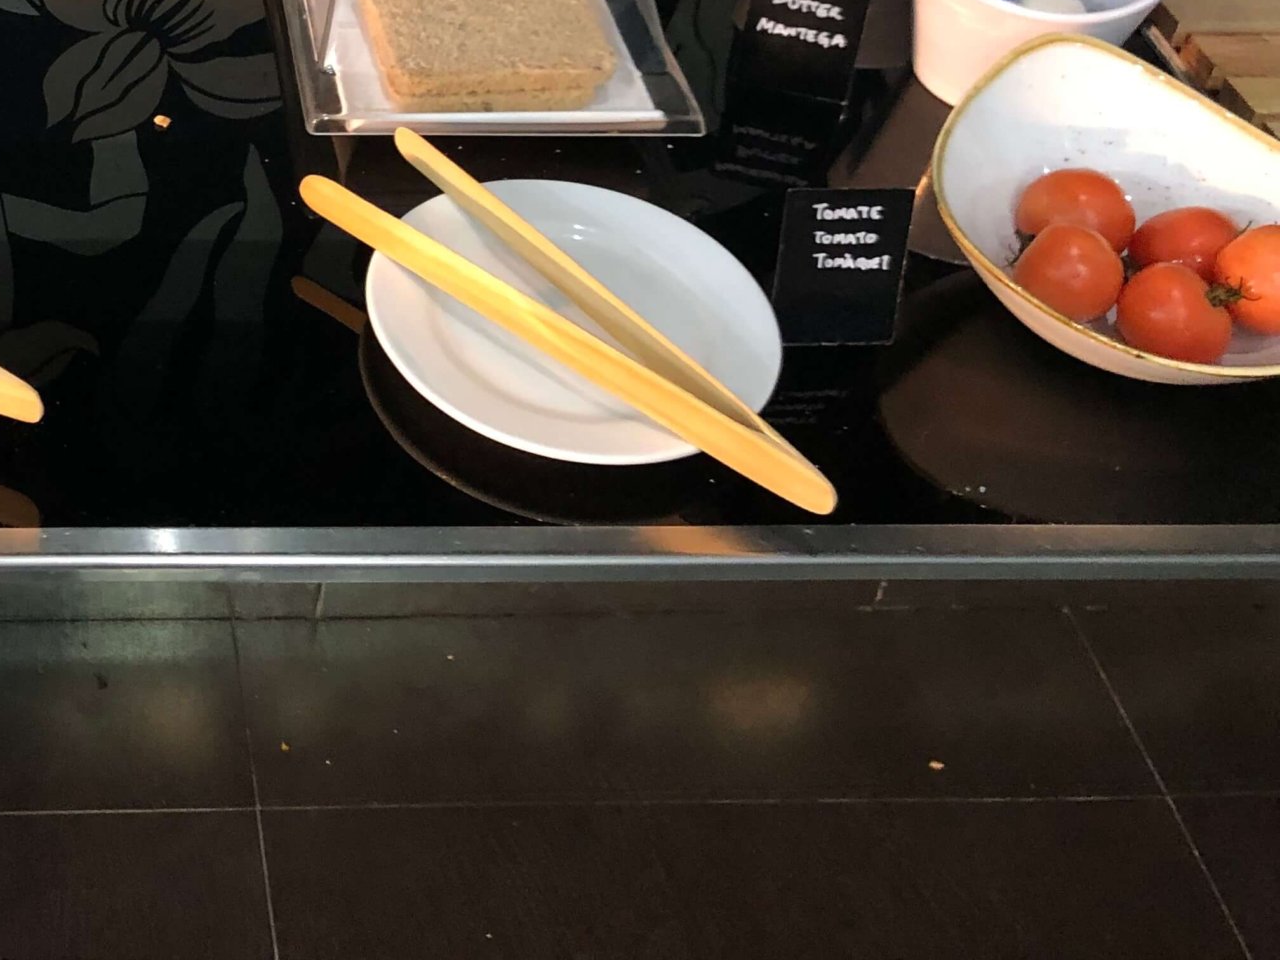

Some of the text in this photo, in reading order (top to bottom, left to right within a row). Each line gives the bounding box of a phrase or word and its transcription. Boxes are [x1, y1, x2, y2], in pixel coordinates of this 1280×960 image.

[755, 17, 848, 49] MANTEGA
[811, 202, 884, 221] TOMATE
[813, 230, 879, 245] TOMATO
